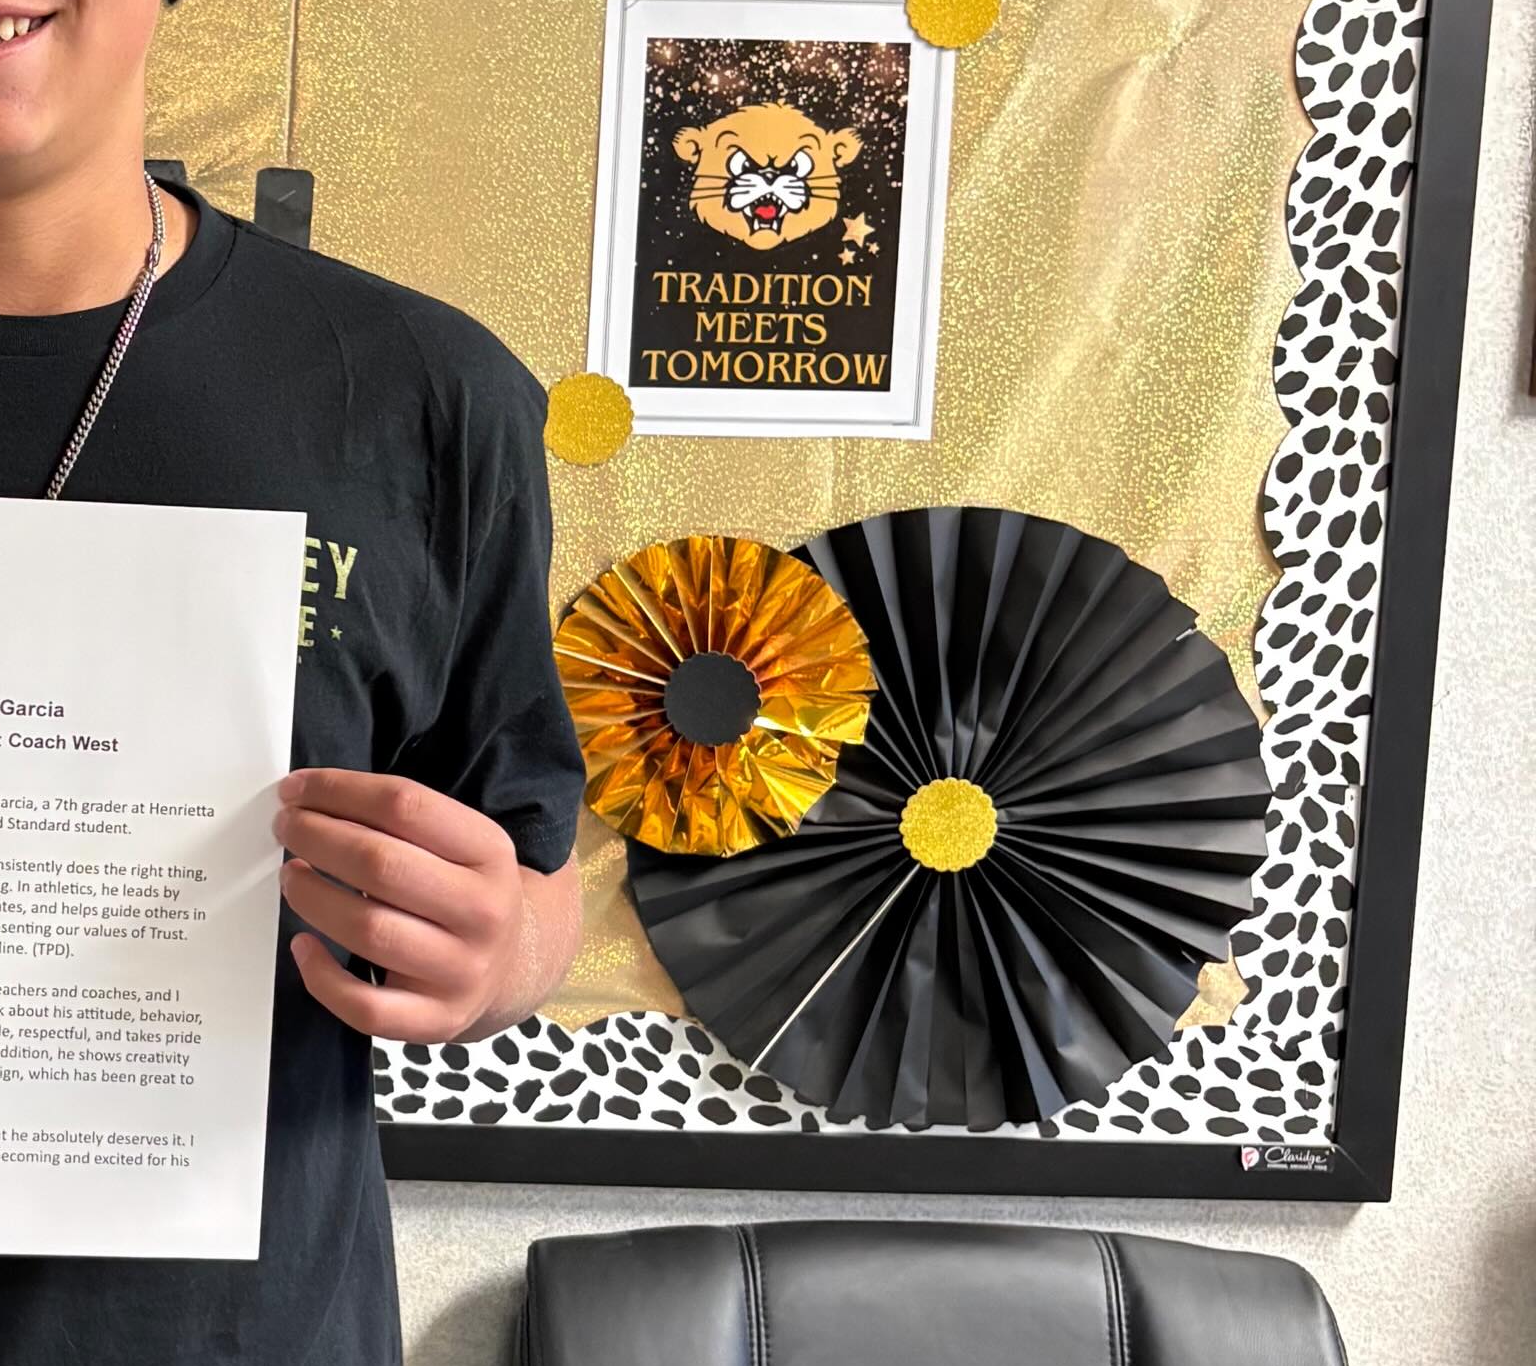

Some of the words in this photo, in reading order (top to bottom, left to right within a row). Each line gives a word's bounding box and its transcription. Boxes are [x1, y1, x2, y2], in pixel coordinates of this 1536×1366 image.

[653, 271, 873, 307] TRADITION
[694, 312, 827, 344] MEETS
[641, 349, 888, 385] TOMORROW
[0, 698, 65, 718] Garcia
[8, 732, 67, 751] Coach
[71, 734, 119, 753] West
[41, 800, 51, 811] a
[54, 797, 78, 812] 7th
[80, 799, 129, 815] grader
[130, 802, 146, 815] at
[148, 802, 215, 818] Henrietta
[7, 816, 71, 832] Standard
[74, 820, 132, 835] student.
[65, 860, 100, 875] does
[103, 862, 128, 876] the
[130, 863, 164, 880] right
[167, 864, 208, 883] thing,
[17, 879, 31, 893] In
[33, 880, 97, 898] athletics,
[100, 882, 119, 897] he
[122, 883, 161, 899] leads
[162, 884, 181, 903] by
[30, 901, 58, 915] and
[61, 901, 99, 919] helps
[100, 904, 141, 920] guide
[144, 905, 190, 921] others
[193, 907, 206, 921] in
[55, 925, 81, 937] our
[83, 923, 128, 939] values
[130, 925, 147, 940] of
[148, 926, 188, 941] Trust.
[32, 941, 75, 960] (TPD).
[51, 984, 78, 999] and
[81, 986, 142, 1003] coaches,
[144, 988, 172, 1002] and
[175, 989, 180, 1003] I
[8, 1003, 50, 1018] about
[52, 1004, 73, 1020] his
[76, 1006, 136, 1024] attitude,
[139, 1007, 203, 1026] behavior,
[18, 1025, 91, 1044] respectful,
[95, 1028, 122, 1042] and
[125, 1028, 162, 1043] takes
[164, 1030, 202, 1047] pride
[57, 1046, 76, 1061] he
[78, 1047, 123, 1063] shows
[125, 1050, 191, 1068] creativity
[28, 1066, 70, 1081] which
[73, 1067, 97, 1082] has
[100, 1068, 137, 1084] been
[139, 1073, 177, 1087] great
[179, 1072, 195, 1086] to
[10, 1128, 29, 1142] he
[31, 1128, 104, 1148] absolutely
[106, 1131, 169, 1147] deserves
[172, 1133, 186, 1147] it.
[190, 1134, 195, 1147] I
[63, 1150, 91, 1164] and
[93, 1151, 144, 1166] excited
[147, 1152, 168, 1167] for
[170, 1153, 190, 1168] his
[1264, 1146, 1327, 1165] Claridge
